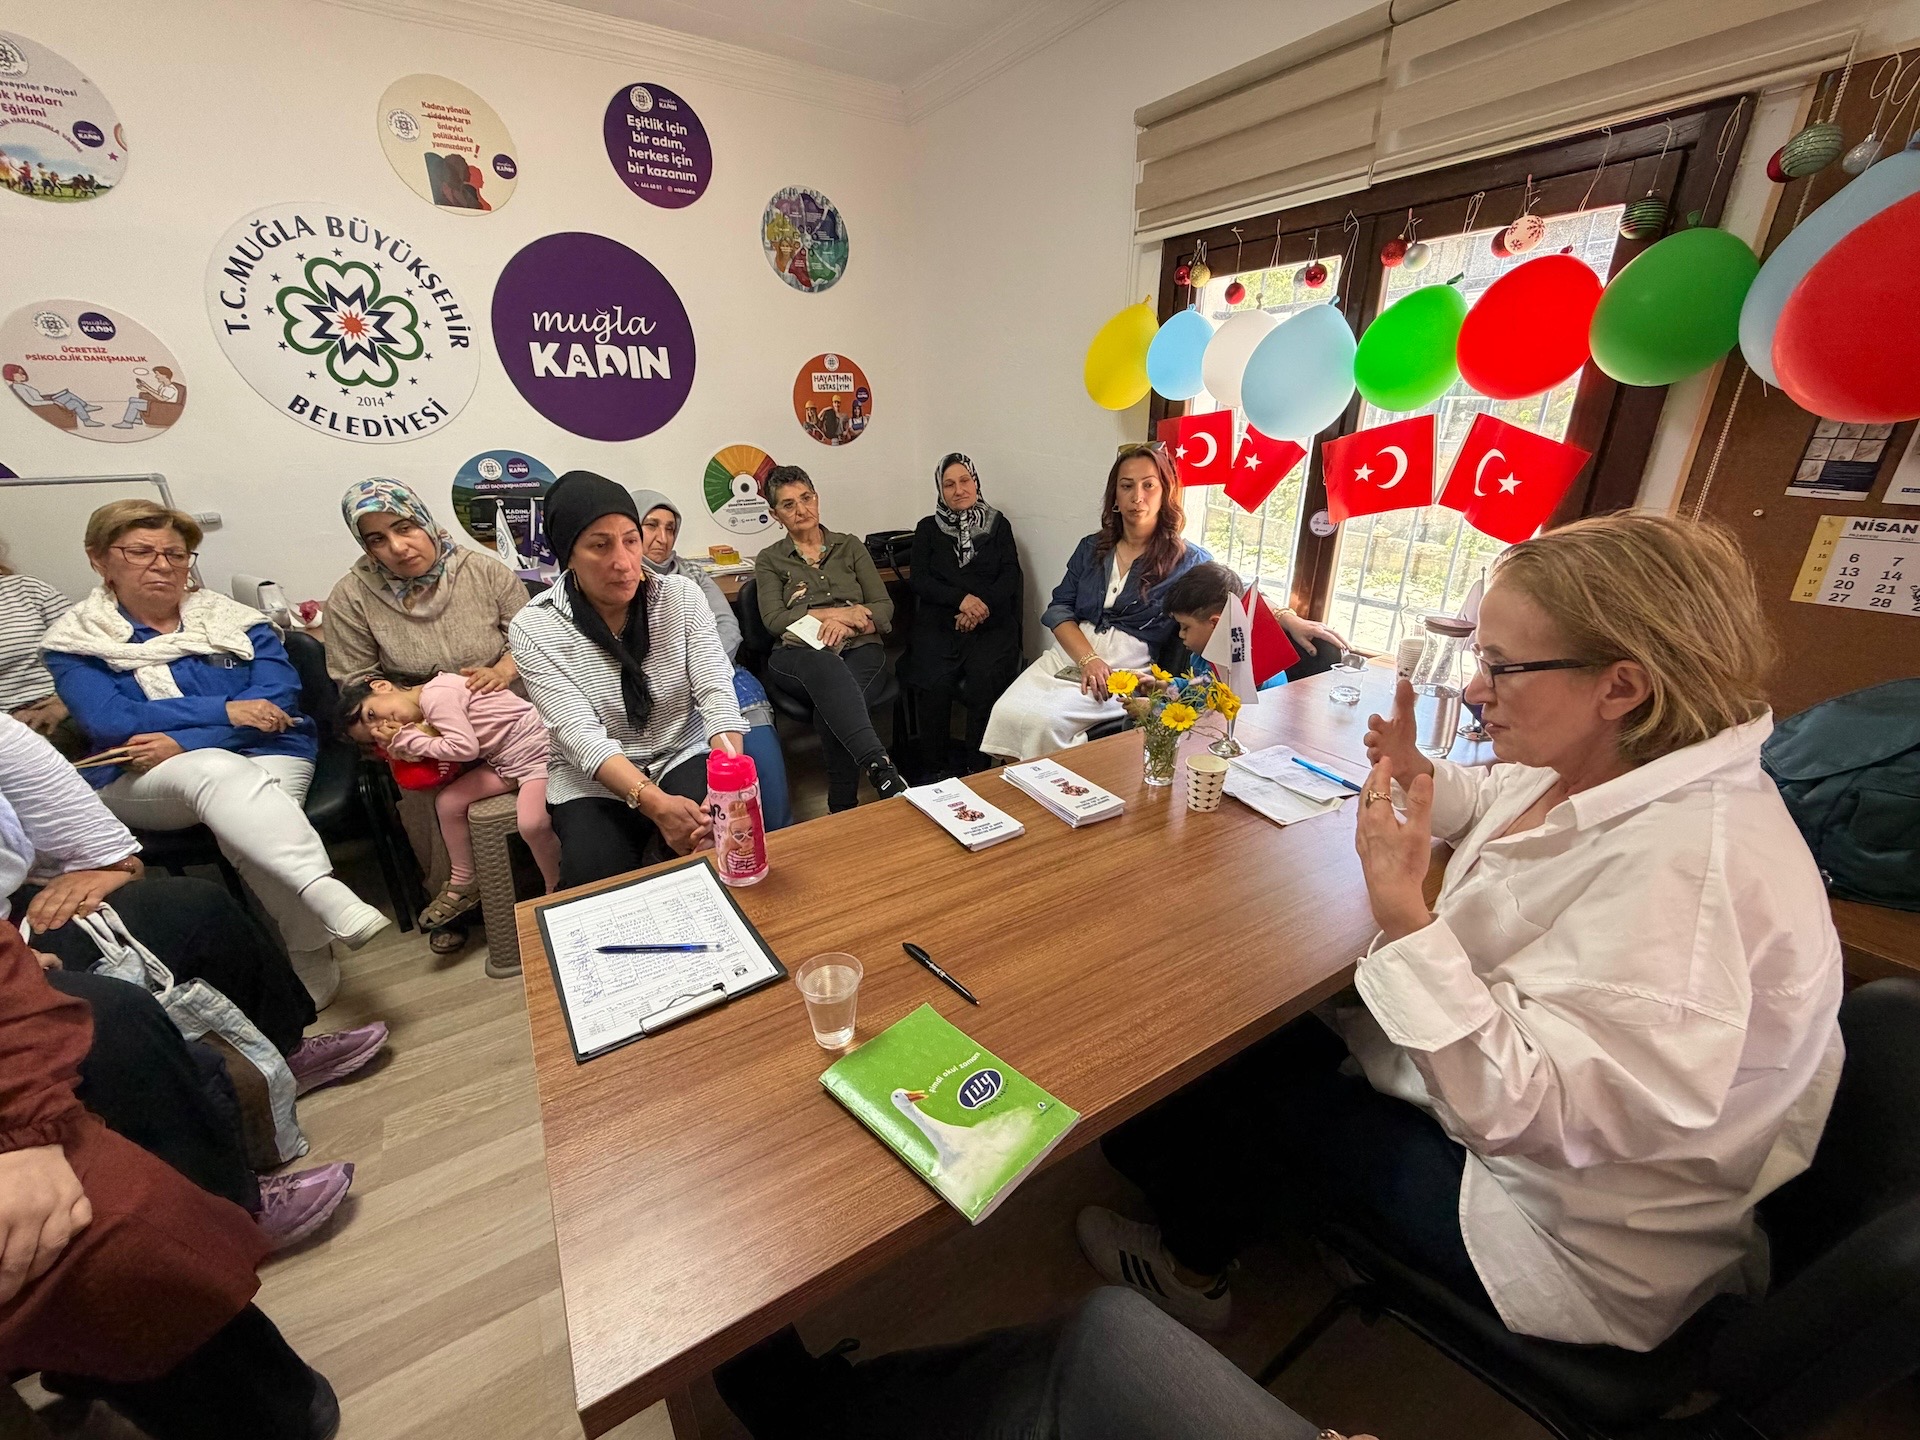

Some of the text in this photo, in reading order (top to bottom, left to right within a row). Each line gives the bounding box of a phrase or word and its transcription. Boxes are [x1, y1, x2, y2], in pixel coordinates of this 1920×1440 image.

[43, 85, 78, 97] Projesi
[14, 91, 63, 107] Hakları
[1, 103, 47, 118] Eğitimi
[421, 101, 472, 116] Kadına yönelik
[437, 121, 464, 133] önleyici
[626, 114, 688, 137] Eşitlik için
[432, 132, 474, 144] politikalarla
[632, 130, 687, 153] bir adım,
[628, 146, 693, 169] herkes için
[627, 161, 698, 183] bir kazanım
[325, 215, 471, 350] BÜYÜKŞEHİR
[82, 325, 114, 334] KADIN
[532, 304, 657, 345] muğla
[61, 345, 108, 354] ÜCRETSİZ
[25, 352, 148, 364] PSİKOLOJİK DANIŞMANLIK
[529, 342, 671, 379] KADIN
[357, 396, 385, 407] 2014
[287, 394, 449, 438] BELEDİYESİ
[1852, 520, 1918, 534] NİSAN
[1849, 553, 1860, 563] 6
[1892, 557, 1904, 567] 7
[1839, 567, 1860, 577] 13
[1880, 571, 1903, 581] 14
[1833, 580, 1855, 590] 20
[1874, 583, 1897, 595] 21
[1828, 592, 1850, 603] 27
[1869, 597, 1892, 608] 28
[928, 1050, 981, 1094] şimdi okul zamanı
[964, 1071, 997, 1106] Lily
